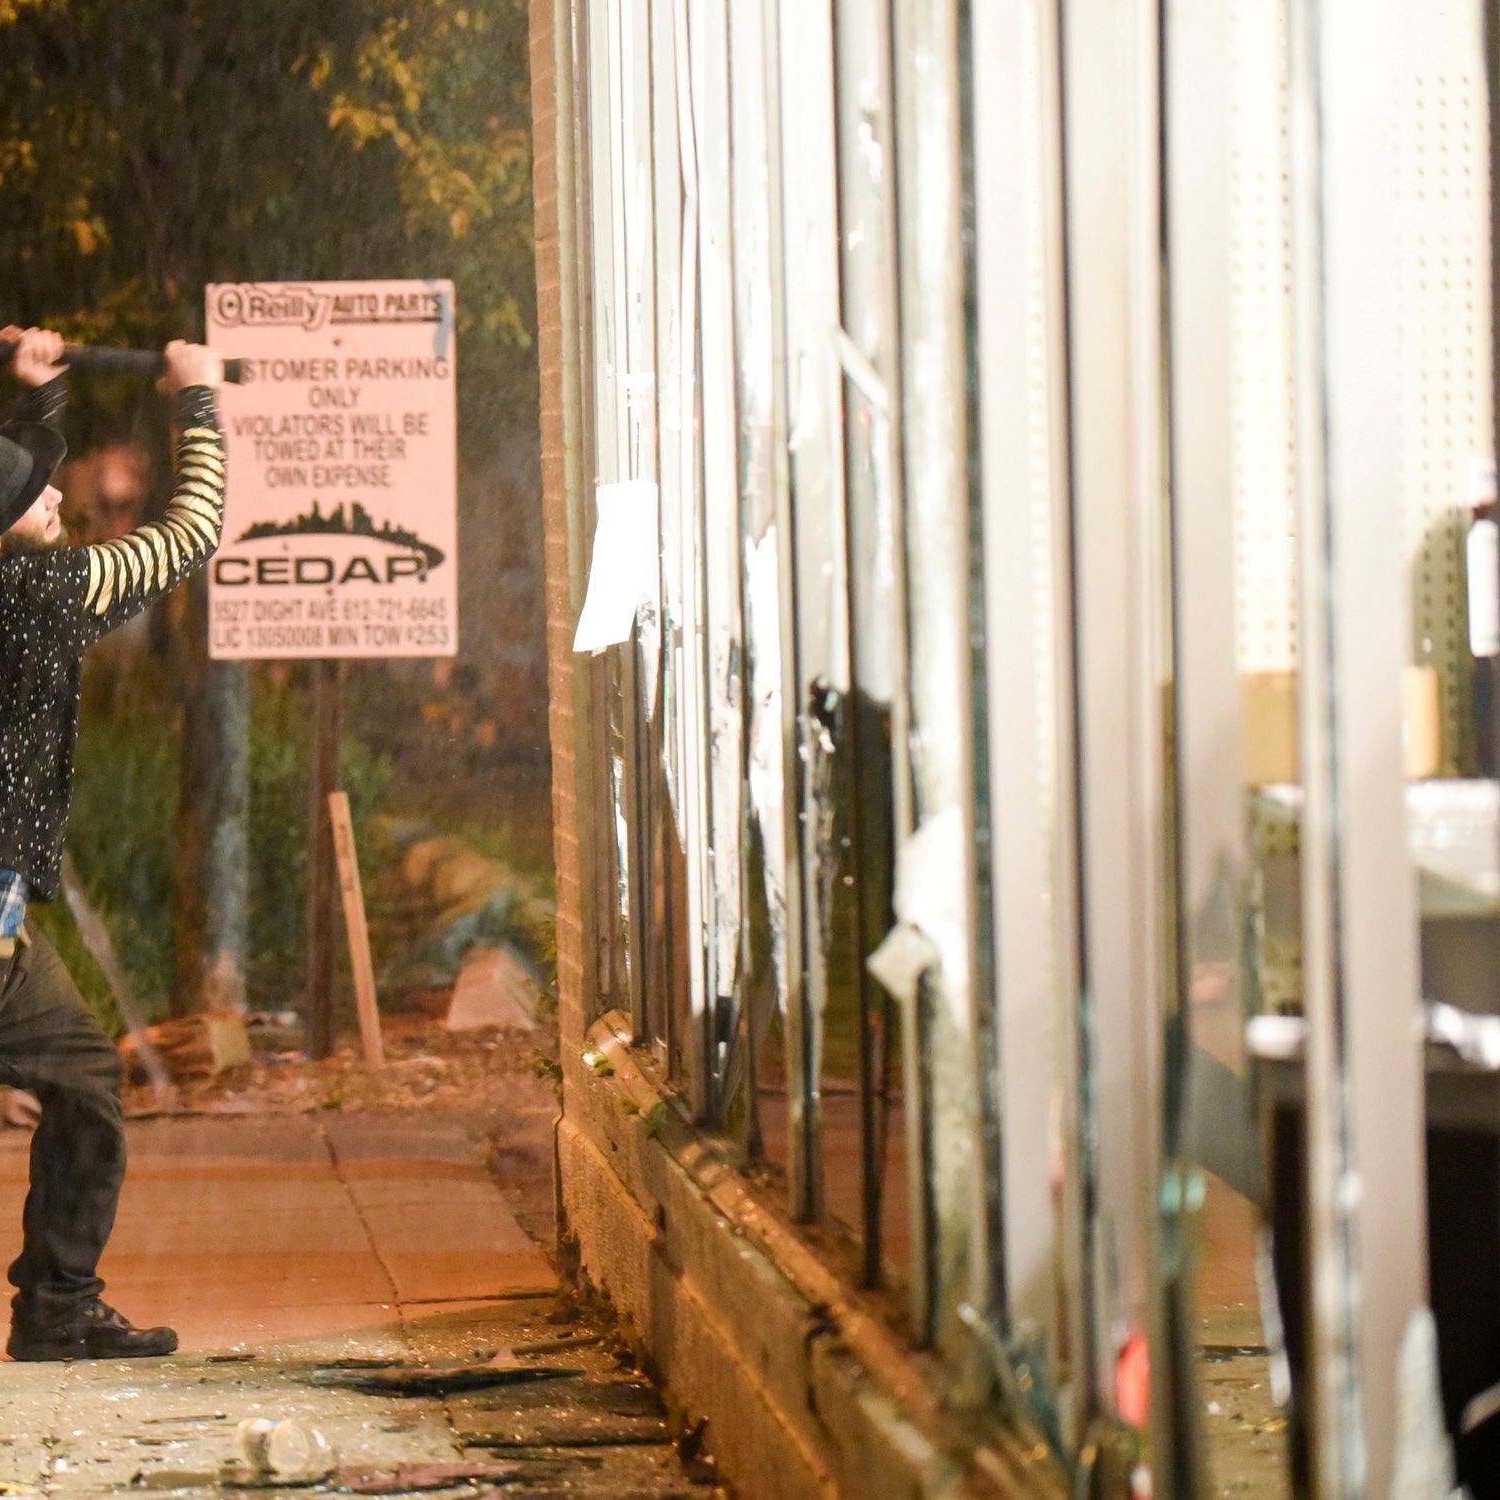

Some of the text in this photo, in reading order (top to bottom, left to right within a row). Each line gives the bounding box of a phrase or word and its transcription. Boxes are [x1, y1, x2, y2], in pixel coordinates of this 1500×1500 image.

[331, 292, 379, 312] AUTO
[384, 292, 443, 312] PARTS
[241, 355, 448, 381] STOMER PARKING
[308, 386, 361, 408] ONLY
[232, 413, 429, 438] VIOLATORS WILL BE
[253, 437, 407, 462] TOWED AT THEIR
[265, 466, 307, 488] OWN
[254, 599, 302, 621] DIGHT
[308, 598, 338, 620] AVE
[328, 626, 358, 647] MIN
[364, 624, 401, 647] TOW
